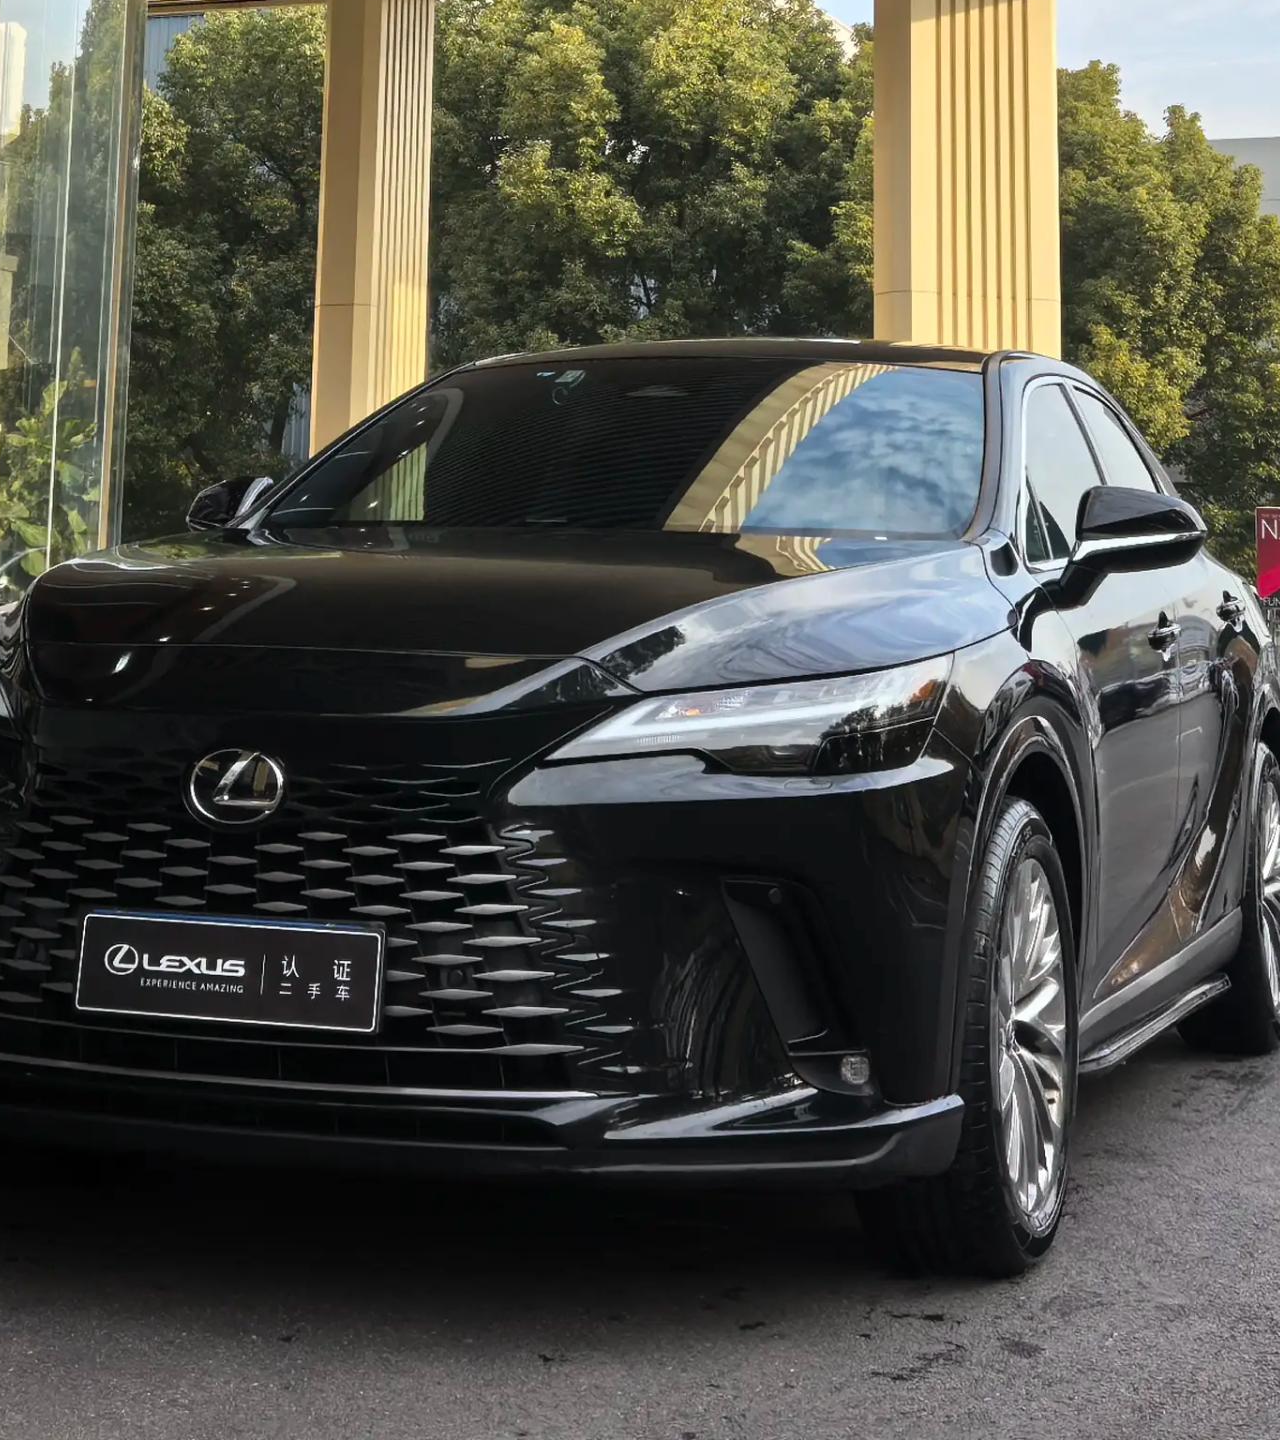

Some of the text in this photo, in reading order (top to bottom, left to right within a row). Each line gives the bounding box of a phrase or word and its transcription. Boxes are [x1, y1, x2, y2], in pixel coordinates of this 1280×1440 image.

[142, 953, 246, 977] LEXUS
[282, 955, 352, 981] 认证
[140, 978, 244, 994] EXPERIENCE AMAZING
[279, 983, 350, 1001] 二手车
